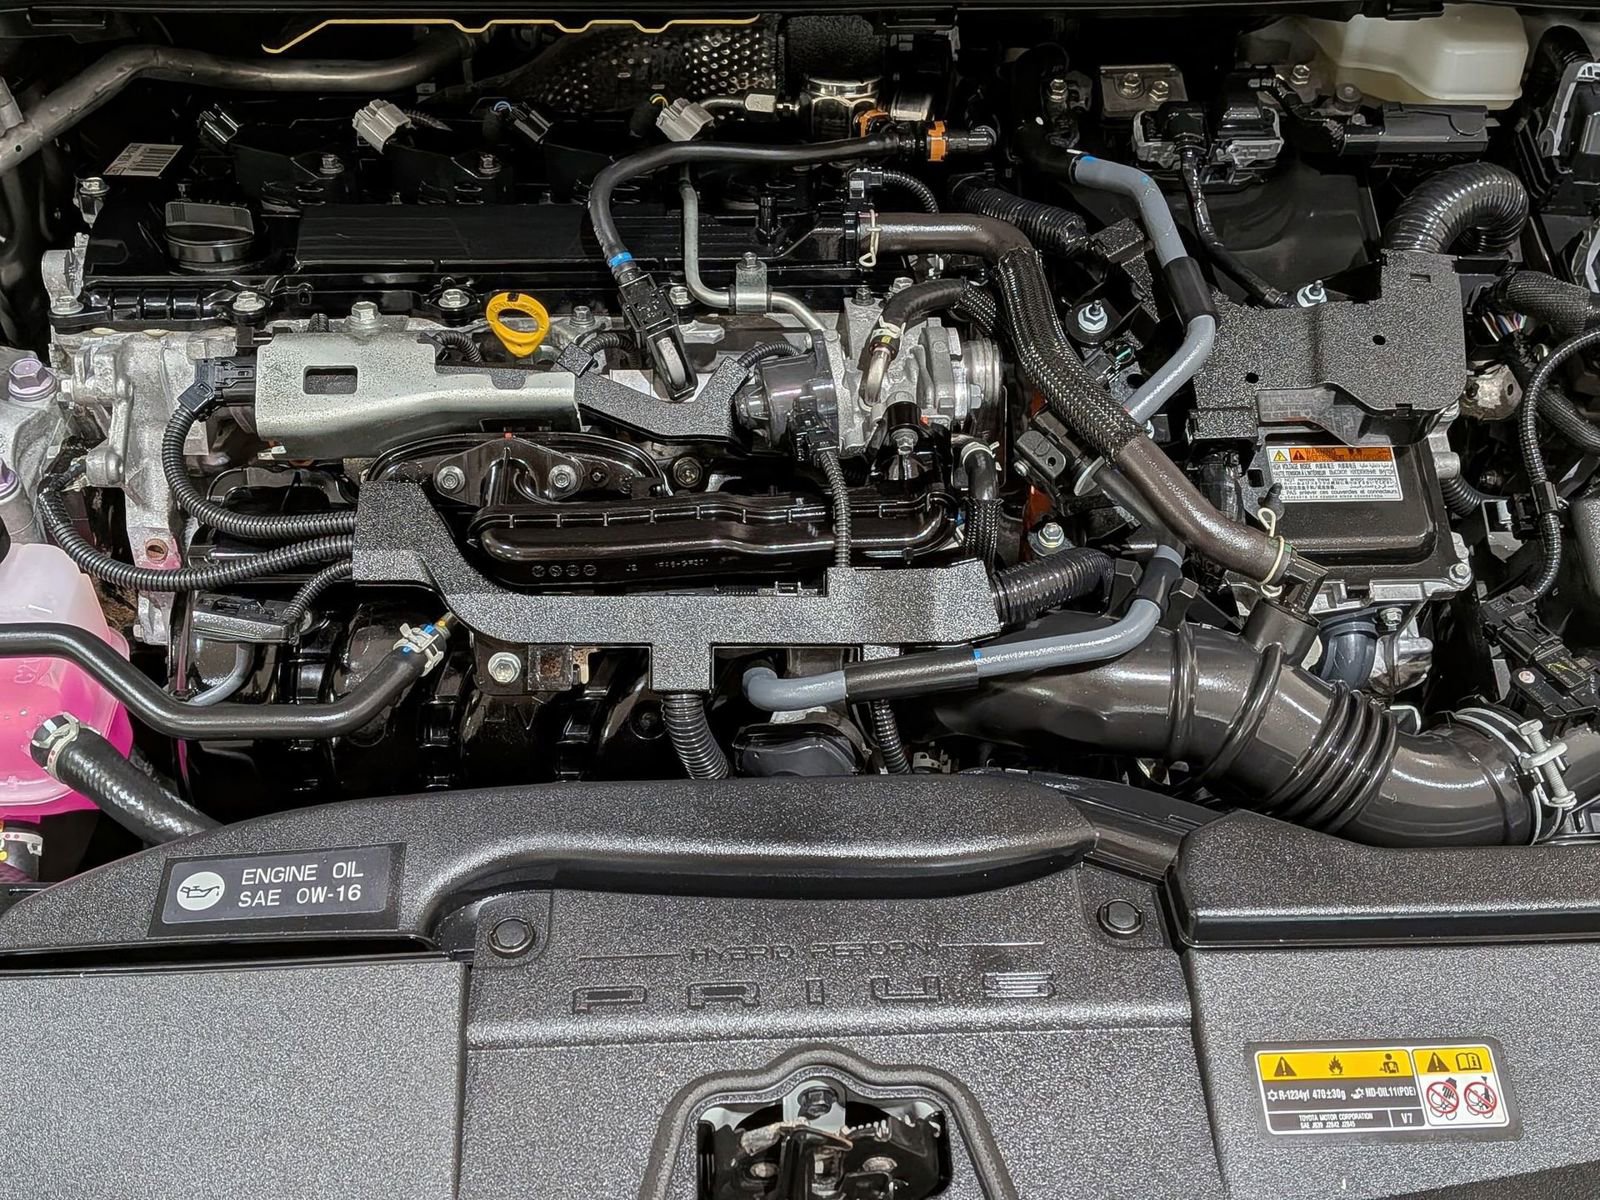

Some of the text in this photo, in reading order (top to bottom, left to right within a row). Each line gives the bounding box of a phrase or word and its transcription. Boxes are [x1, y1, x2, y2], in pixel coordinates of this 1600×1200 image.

[241, 861, 364, 885] ENGINE OIL
[238, 885, 362, 907] SAE 0W-16
[1312, 1088, 1347, 1100] 470±30g
[1319, 1113, 1337, 1121] MOTOR
[1338, 1112, 1374, 1120] CORPORATION
[1401, 1113, 1413, 1124] V7
